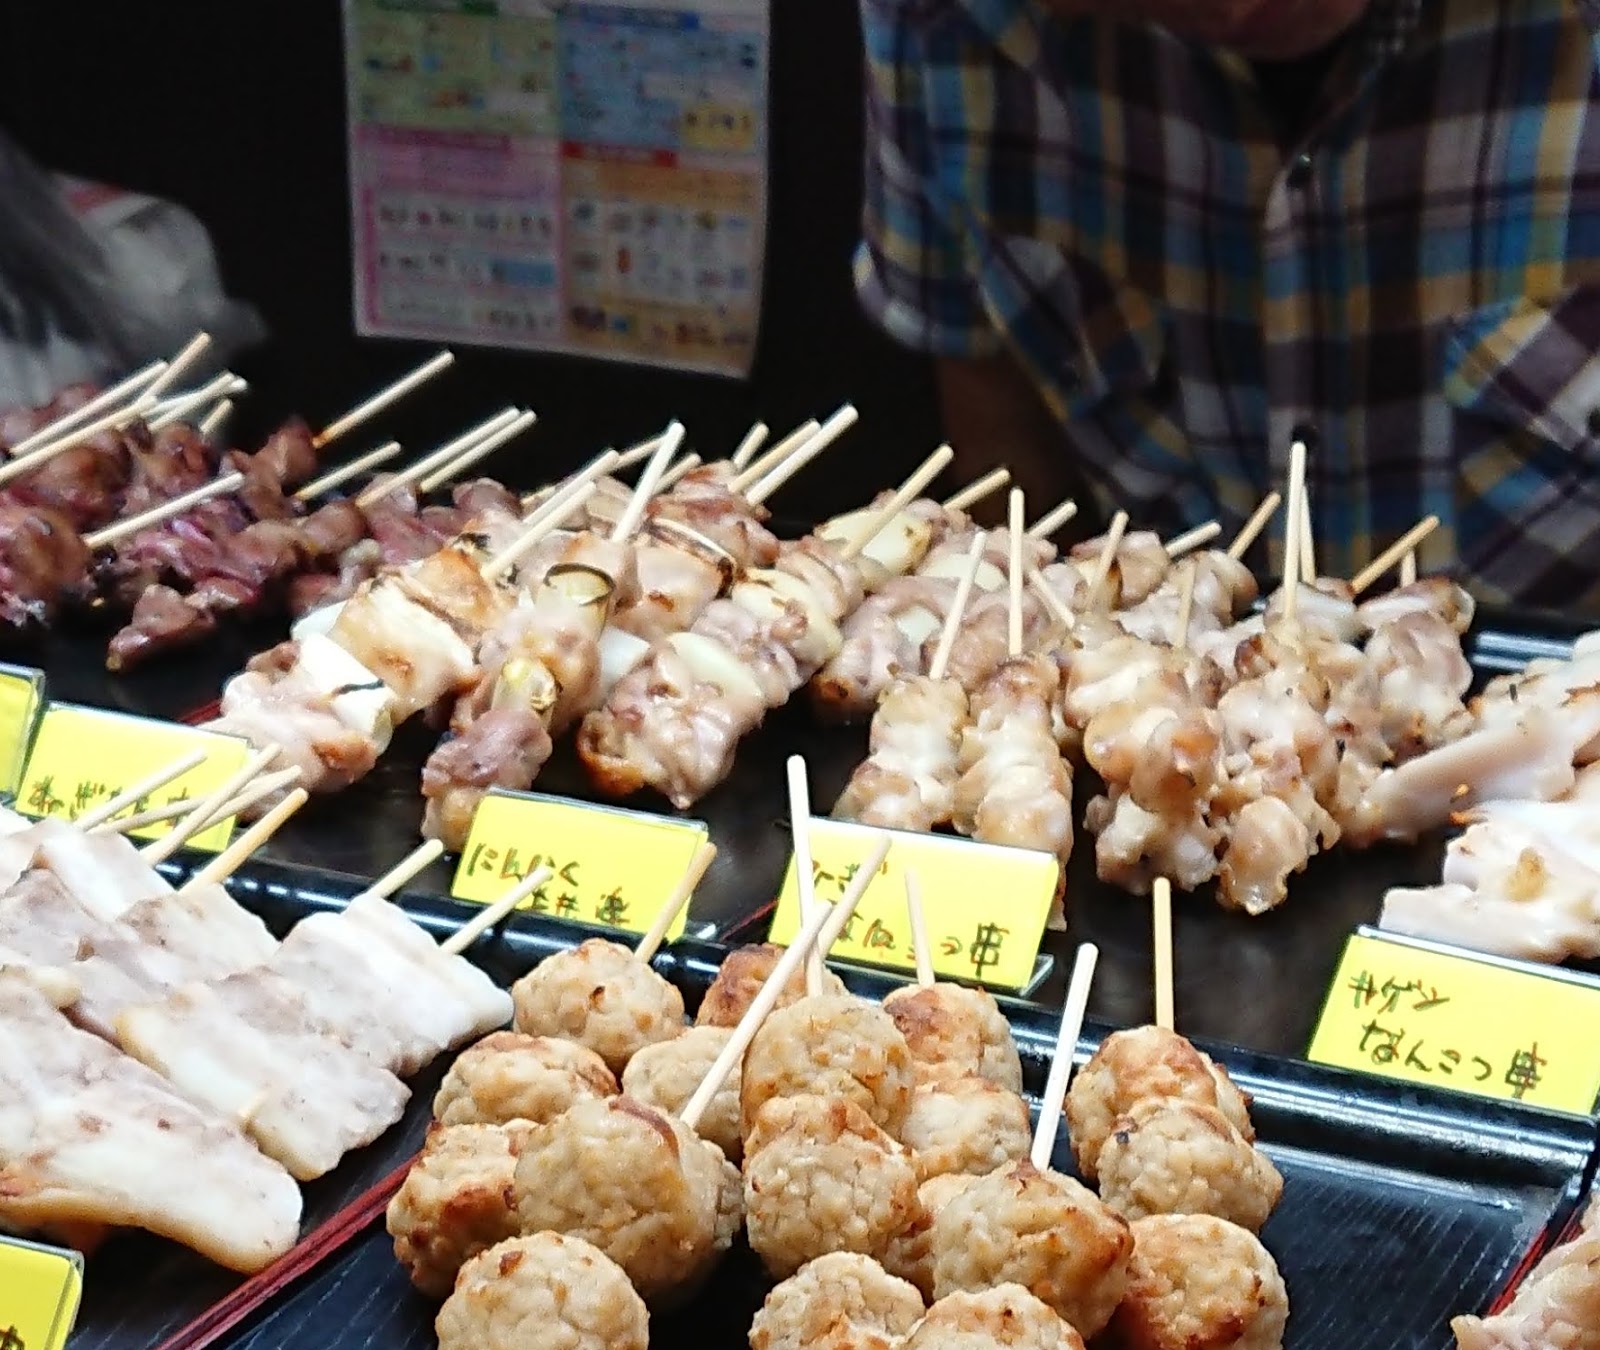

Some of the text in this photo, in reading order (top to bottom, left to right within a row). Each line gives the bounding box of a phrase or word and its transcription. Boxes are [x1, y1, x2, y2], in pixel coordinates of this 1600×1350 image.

[1358, 1018, 1548, 1102] なんこつ串
